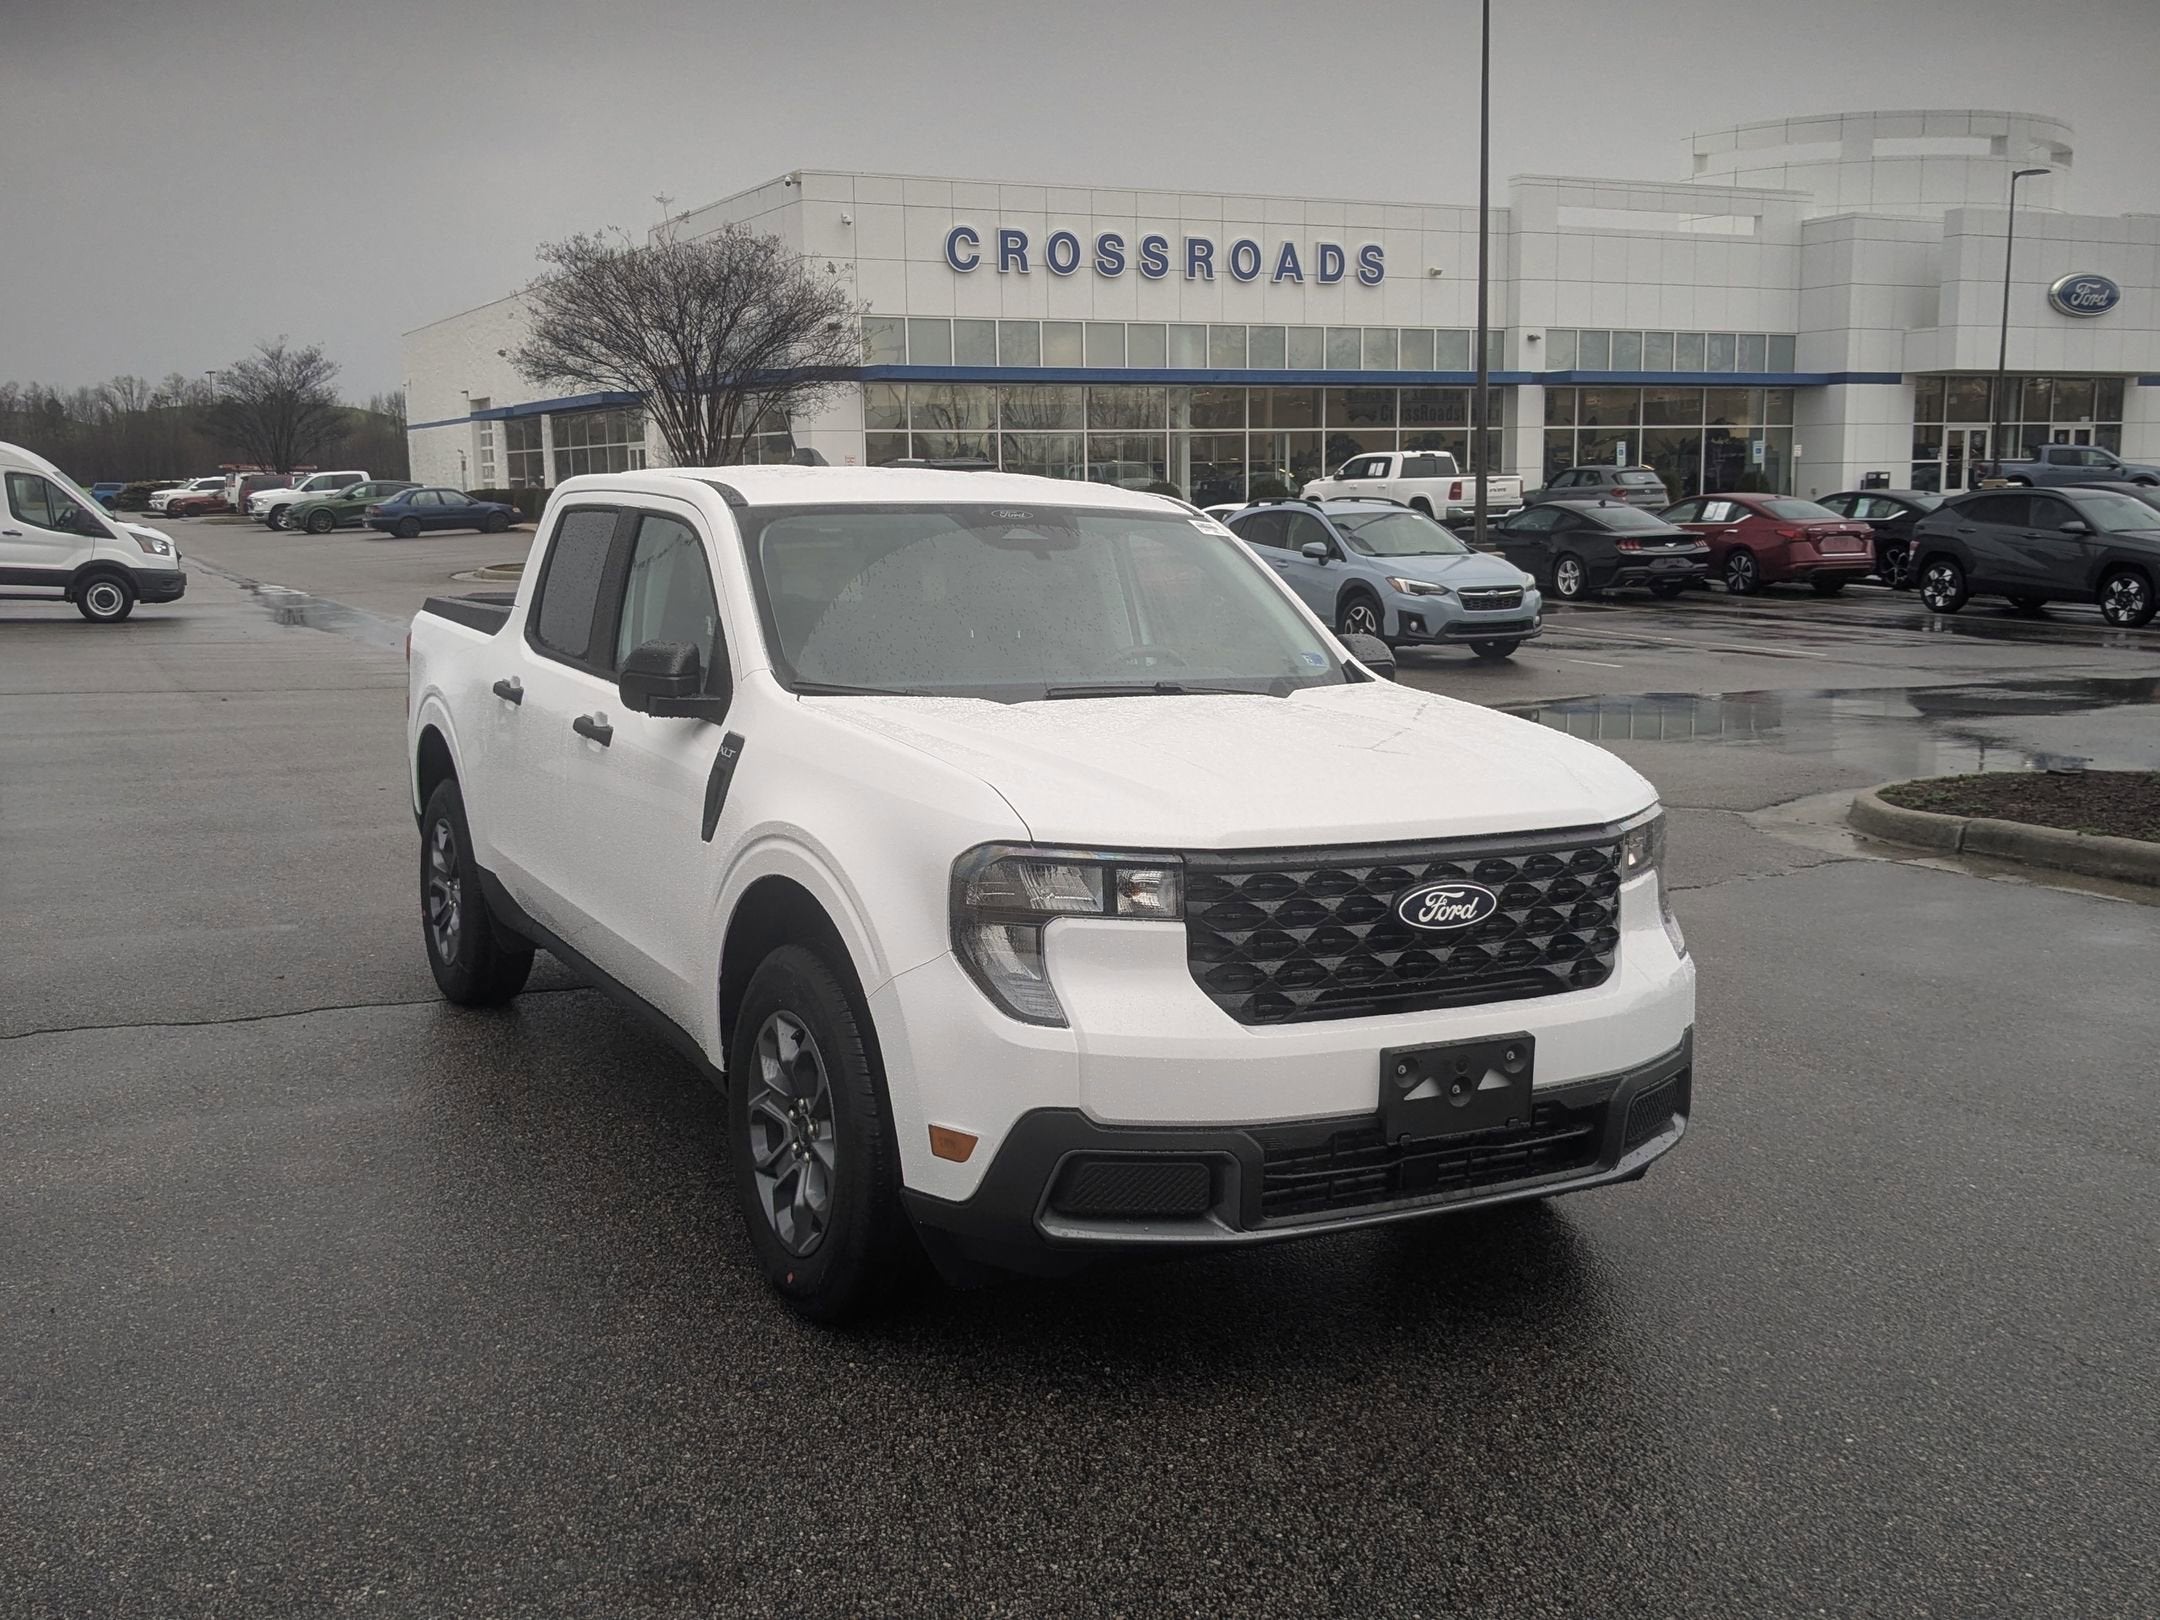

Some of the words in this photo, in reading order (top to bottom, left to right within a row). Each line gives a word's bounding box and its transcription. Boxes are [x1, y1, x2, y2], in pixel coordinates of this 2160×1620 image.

[945, 225, 1386, 286] CROSSROADS
[2070, 282, 2110, 306] Ford
[1000, 510, 1025, 518] Ford
[720, 745, 737, 758] XLT
[1418, 891, 1479, 922] Ford
